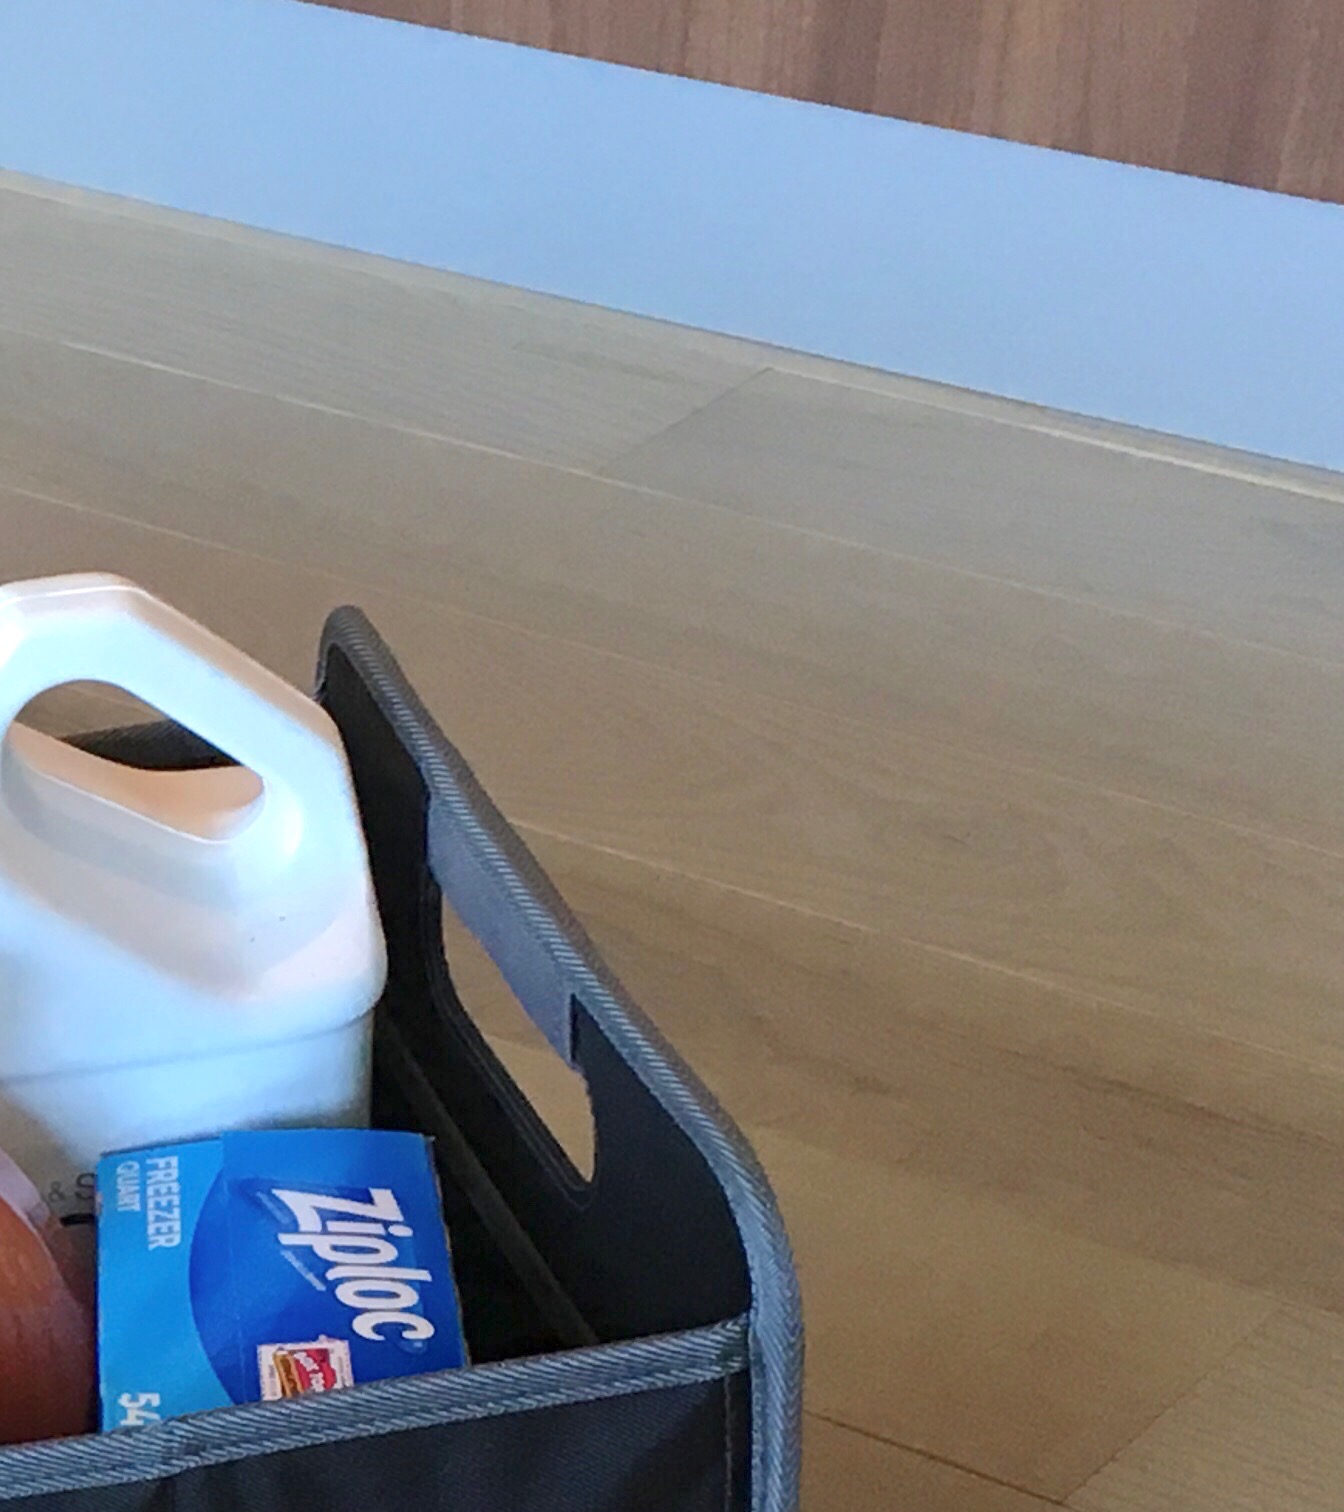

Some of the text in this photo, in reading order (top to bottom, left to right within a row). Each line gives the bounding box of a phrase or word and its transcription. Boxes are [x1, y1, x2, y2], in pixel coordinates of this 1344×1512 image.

[115, 1159, 142, 1212] QUART
[145, 1155, 182, 1251] FREEZER
[271, 1187, 436, 1342] Ziploc
